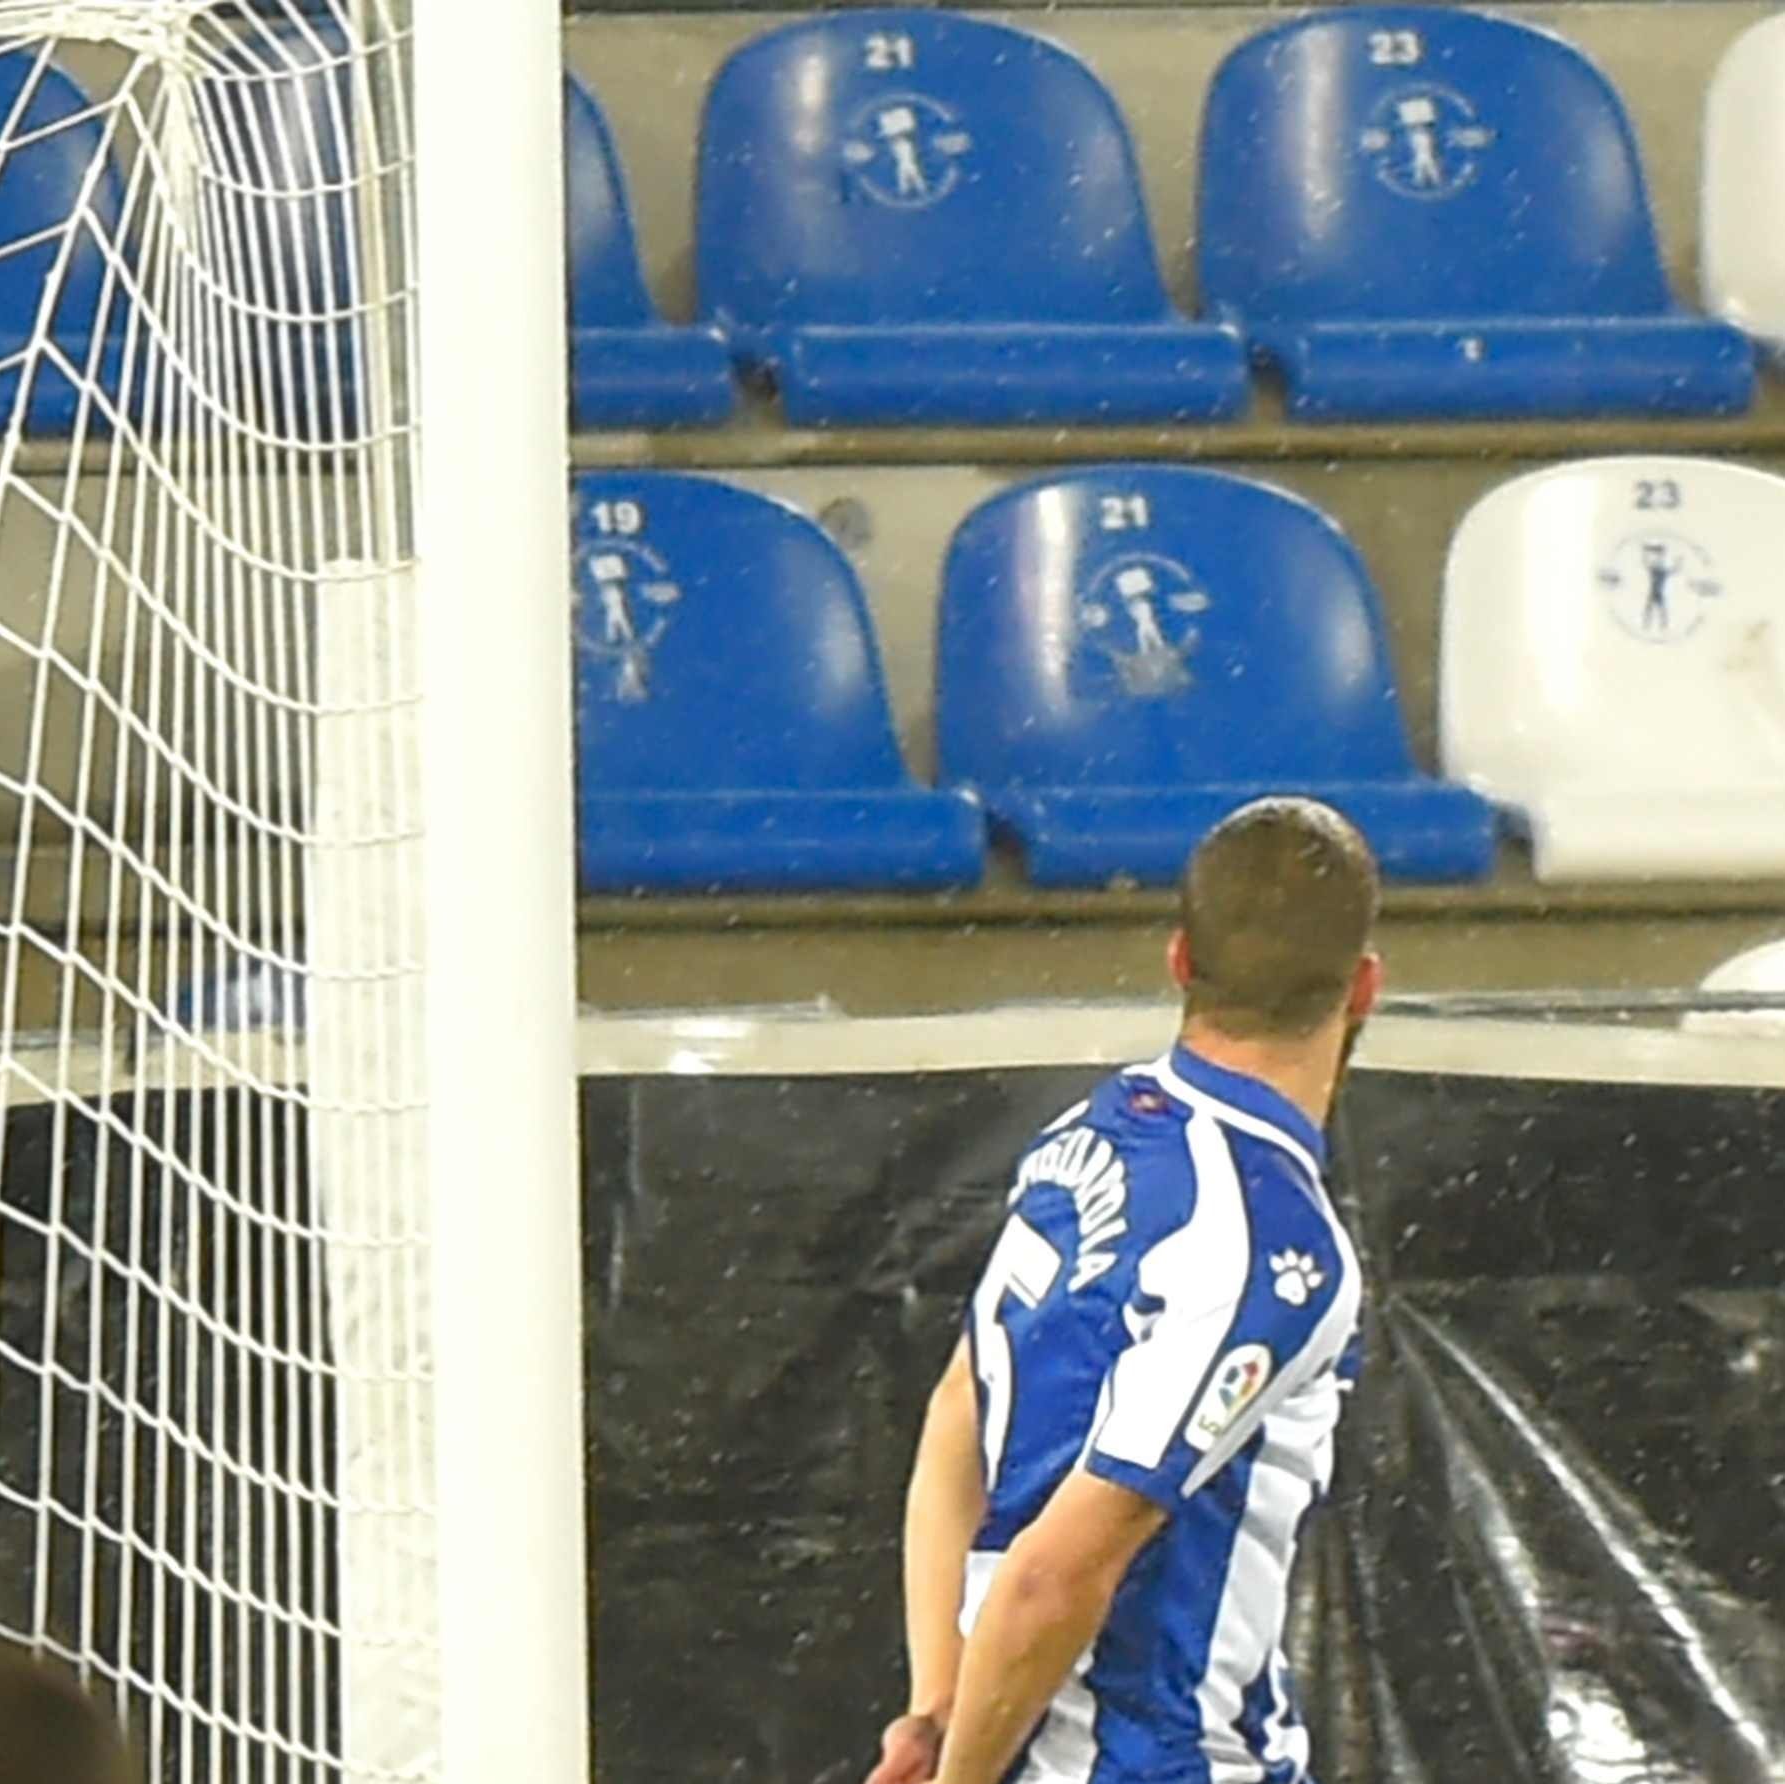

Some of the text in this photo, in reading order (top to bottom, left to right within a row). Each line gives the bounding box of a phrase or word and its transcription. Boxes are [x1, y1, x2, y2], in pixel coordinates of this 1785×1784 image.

[867, 35, 912, 68] 21
[1370, 31, 1420, 65] 23
[1635, 479, 1682, 511] 23
[592, 501, 640, 533] 19
[1101, 496, 1148, 530] 21
